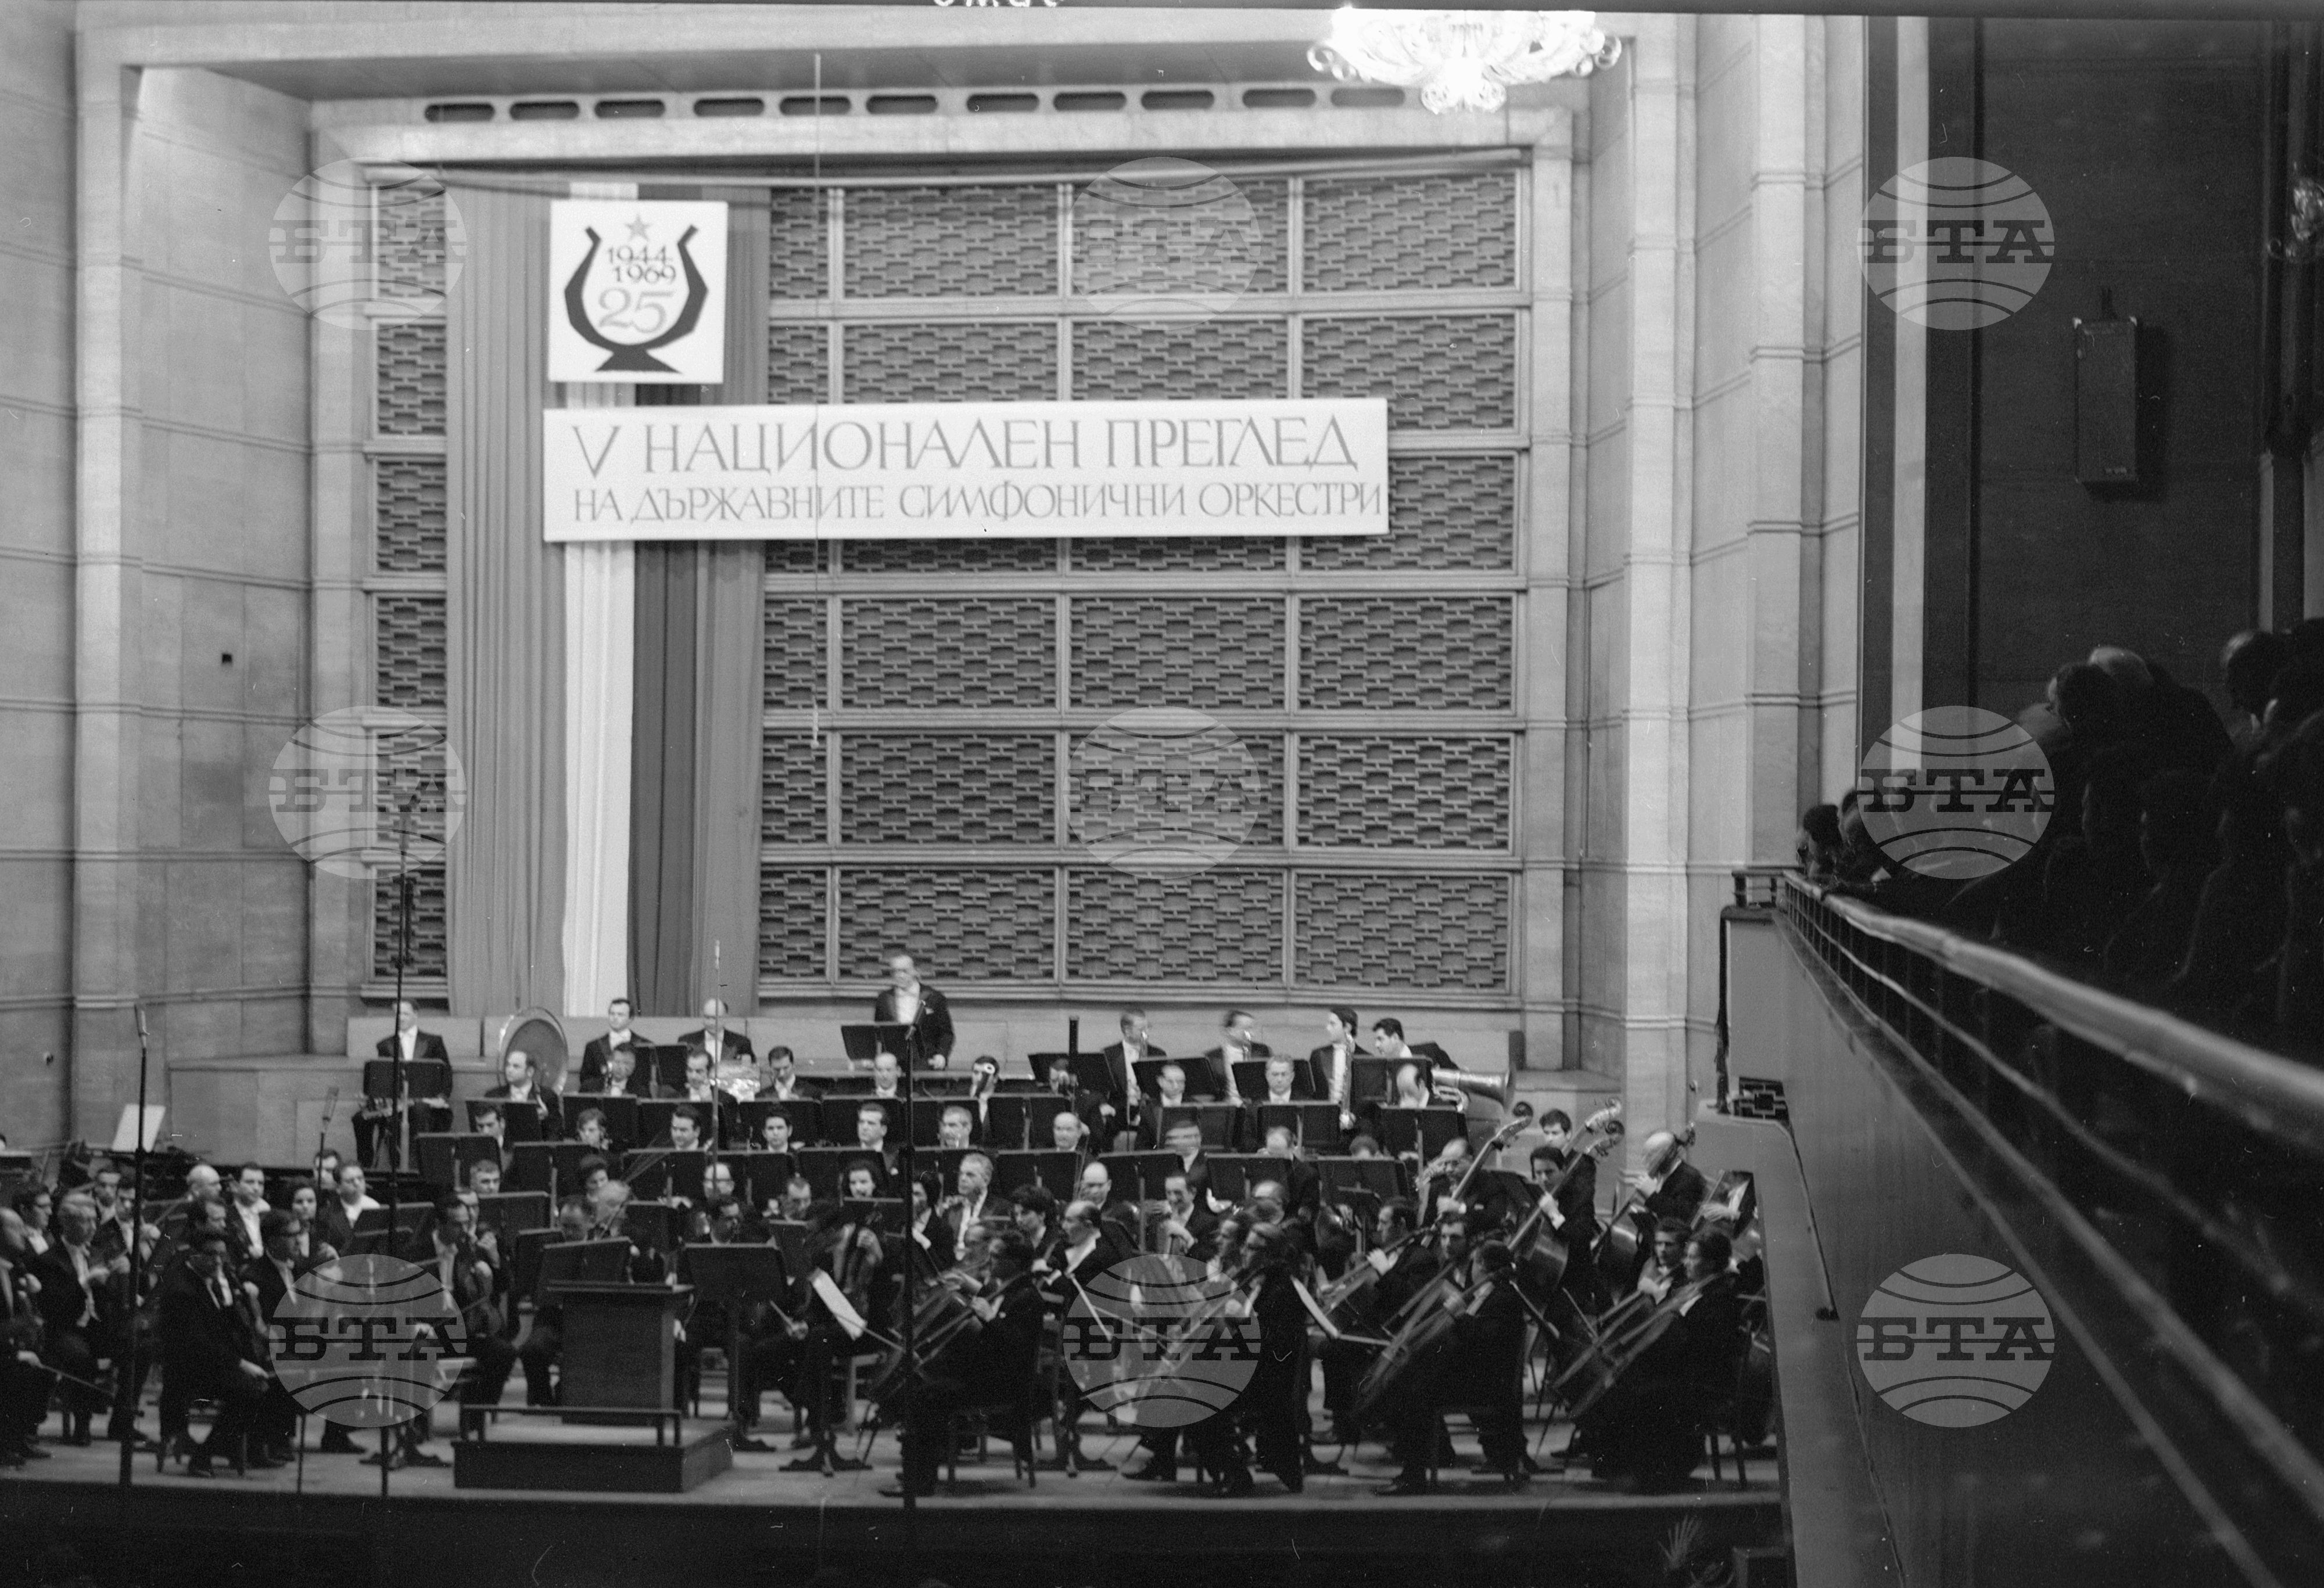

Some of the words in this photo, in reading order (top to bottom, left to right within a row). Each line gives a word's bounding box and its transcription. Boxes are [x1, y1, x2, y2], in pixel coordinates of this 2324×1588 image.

[607, 245, 672, 265] 1944
[612, 264, 676, 285] 1969
[598, 288, 675, 334] 25
[572, 425, 622, 479] V
[643, 417, 1081, 474] НАЦИОНАЛЕН
[1106, 415, 1358, 472] ПРЕГЛЕД
[575, 488, 623, 522] НА
[631, 484, 885, 524] ДЪРЖАВНИТЕ
[899, 480, 1187, 520] СИМФОНИЧНИ
[1199, 483, 1382, 518] ОРКЕСТРИ
